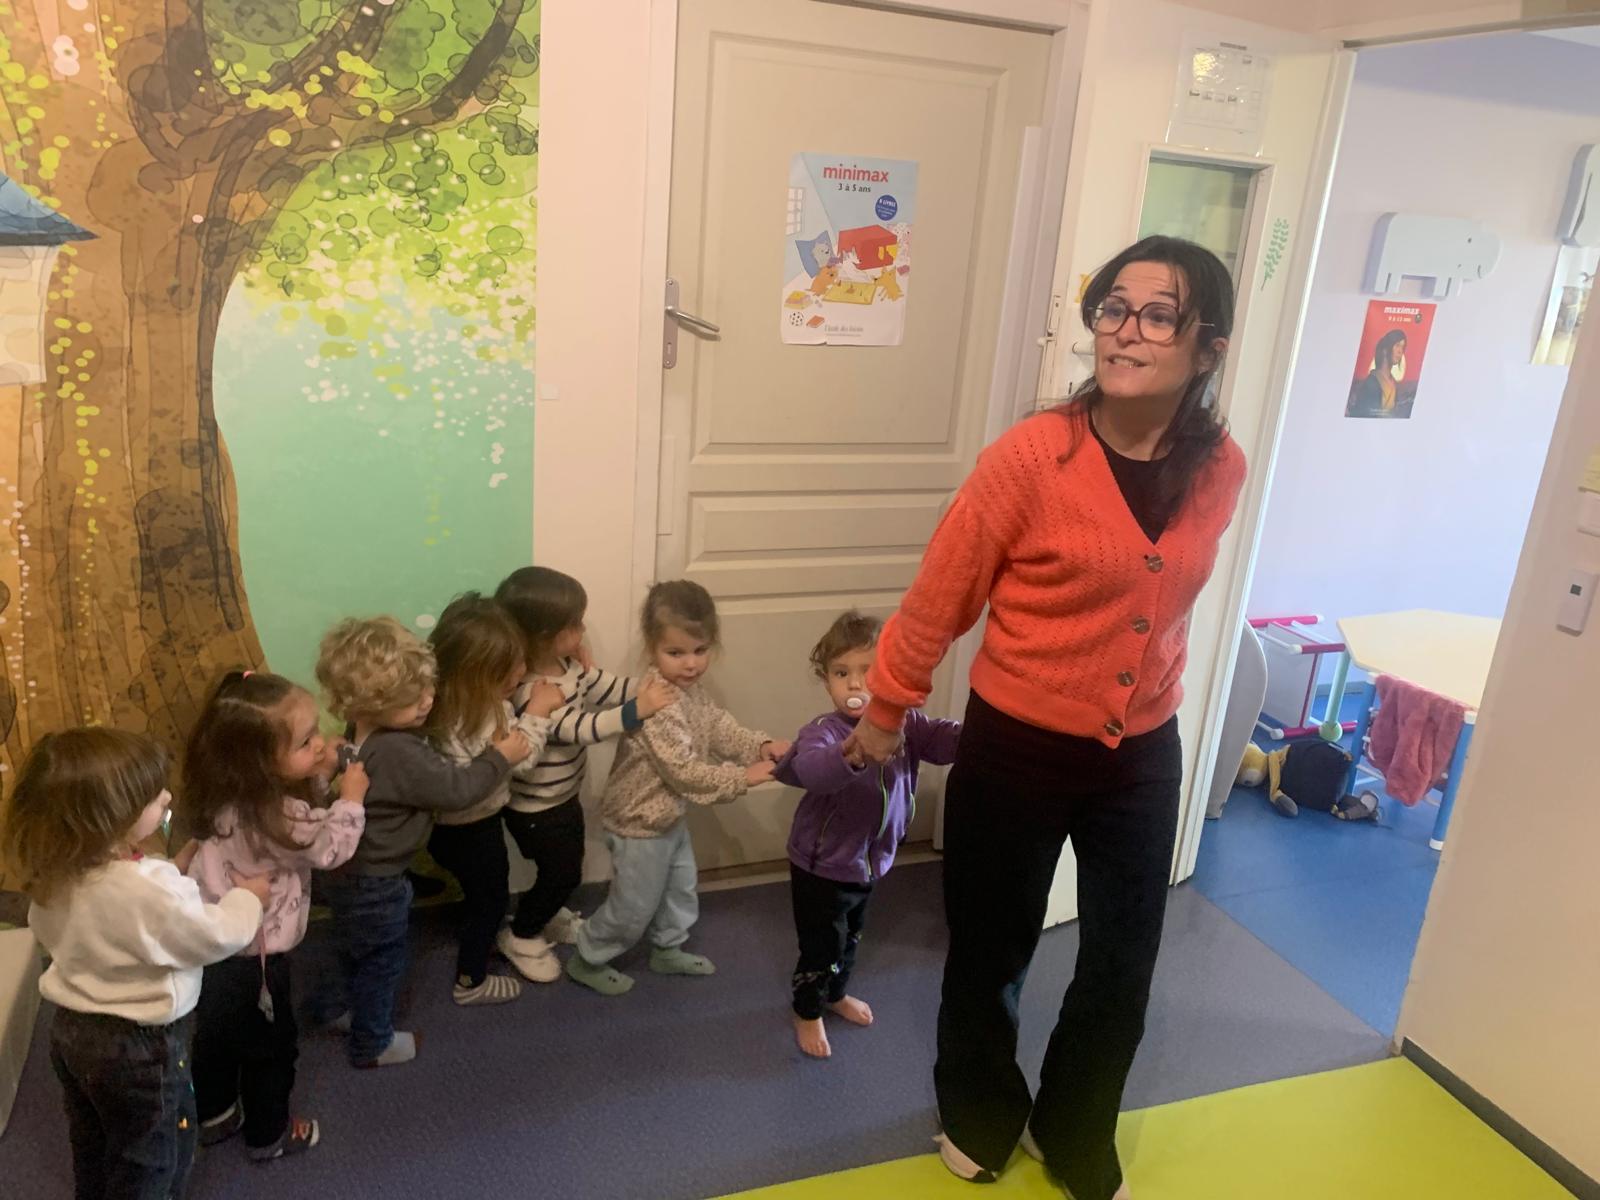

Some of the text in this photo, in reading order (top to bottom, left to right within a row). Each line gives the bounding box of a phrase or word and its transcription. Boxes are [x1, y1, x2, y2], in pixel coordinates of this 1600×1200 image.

[823, 164, 889, 183] minimax
[838, 183, 843, 191] 3
[845, 183, 850, 192] à
[852, 184, 857, 192] 5
[1384, 306, 1420, 315] maximax
